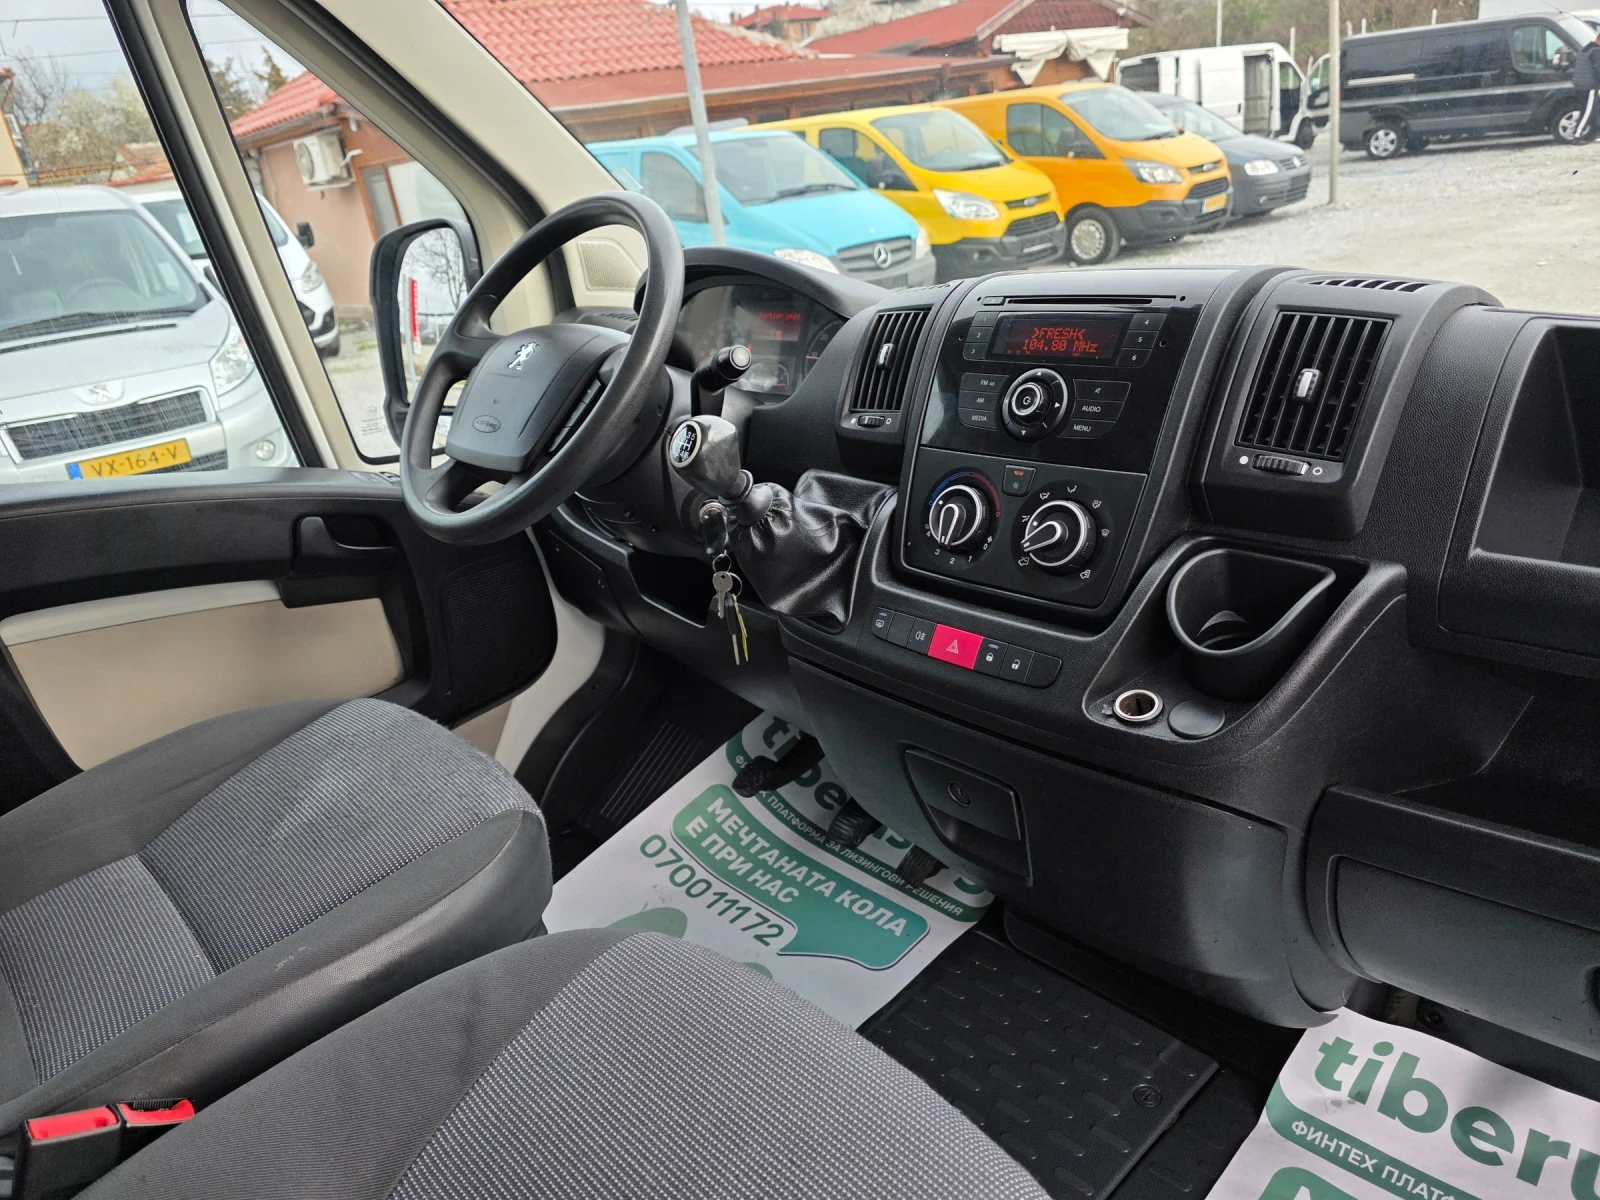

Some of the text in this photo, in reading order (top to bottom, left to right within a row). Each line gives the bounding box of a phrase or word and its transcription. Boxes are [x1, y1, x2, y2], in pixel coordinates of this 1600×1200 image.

[1023, 339, 1098, 353] 104.80 MHz
[1072, 424, 1092, 432] MENU
[1081, 405, 1101, 413] AUDIO
[90, 445, 178, 476] VX-164-V
[685, 815, 799, 903] Е ПРИ НАС
[706, 796, 837, 898] МЕЧТАНАТА
[835, 889, 907, 937] КОЛА
[767, 795, 826, 844] ПЛАТФОРМА
[825, 840, 842, 853] ЗА
[840, 848, 905, 886] ЛИЗИНГОВИ
[639, 834, 785, 947] 070011172
[1291, 1120, 1378, 1173] ФИНТЕХ
